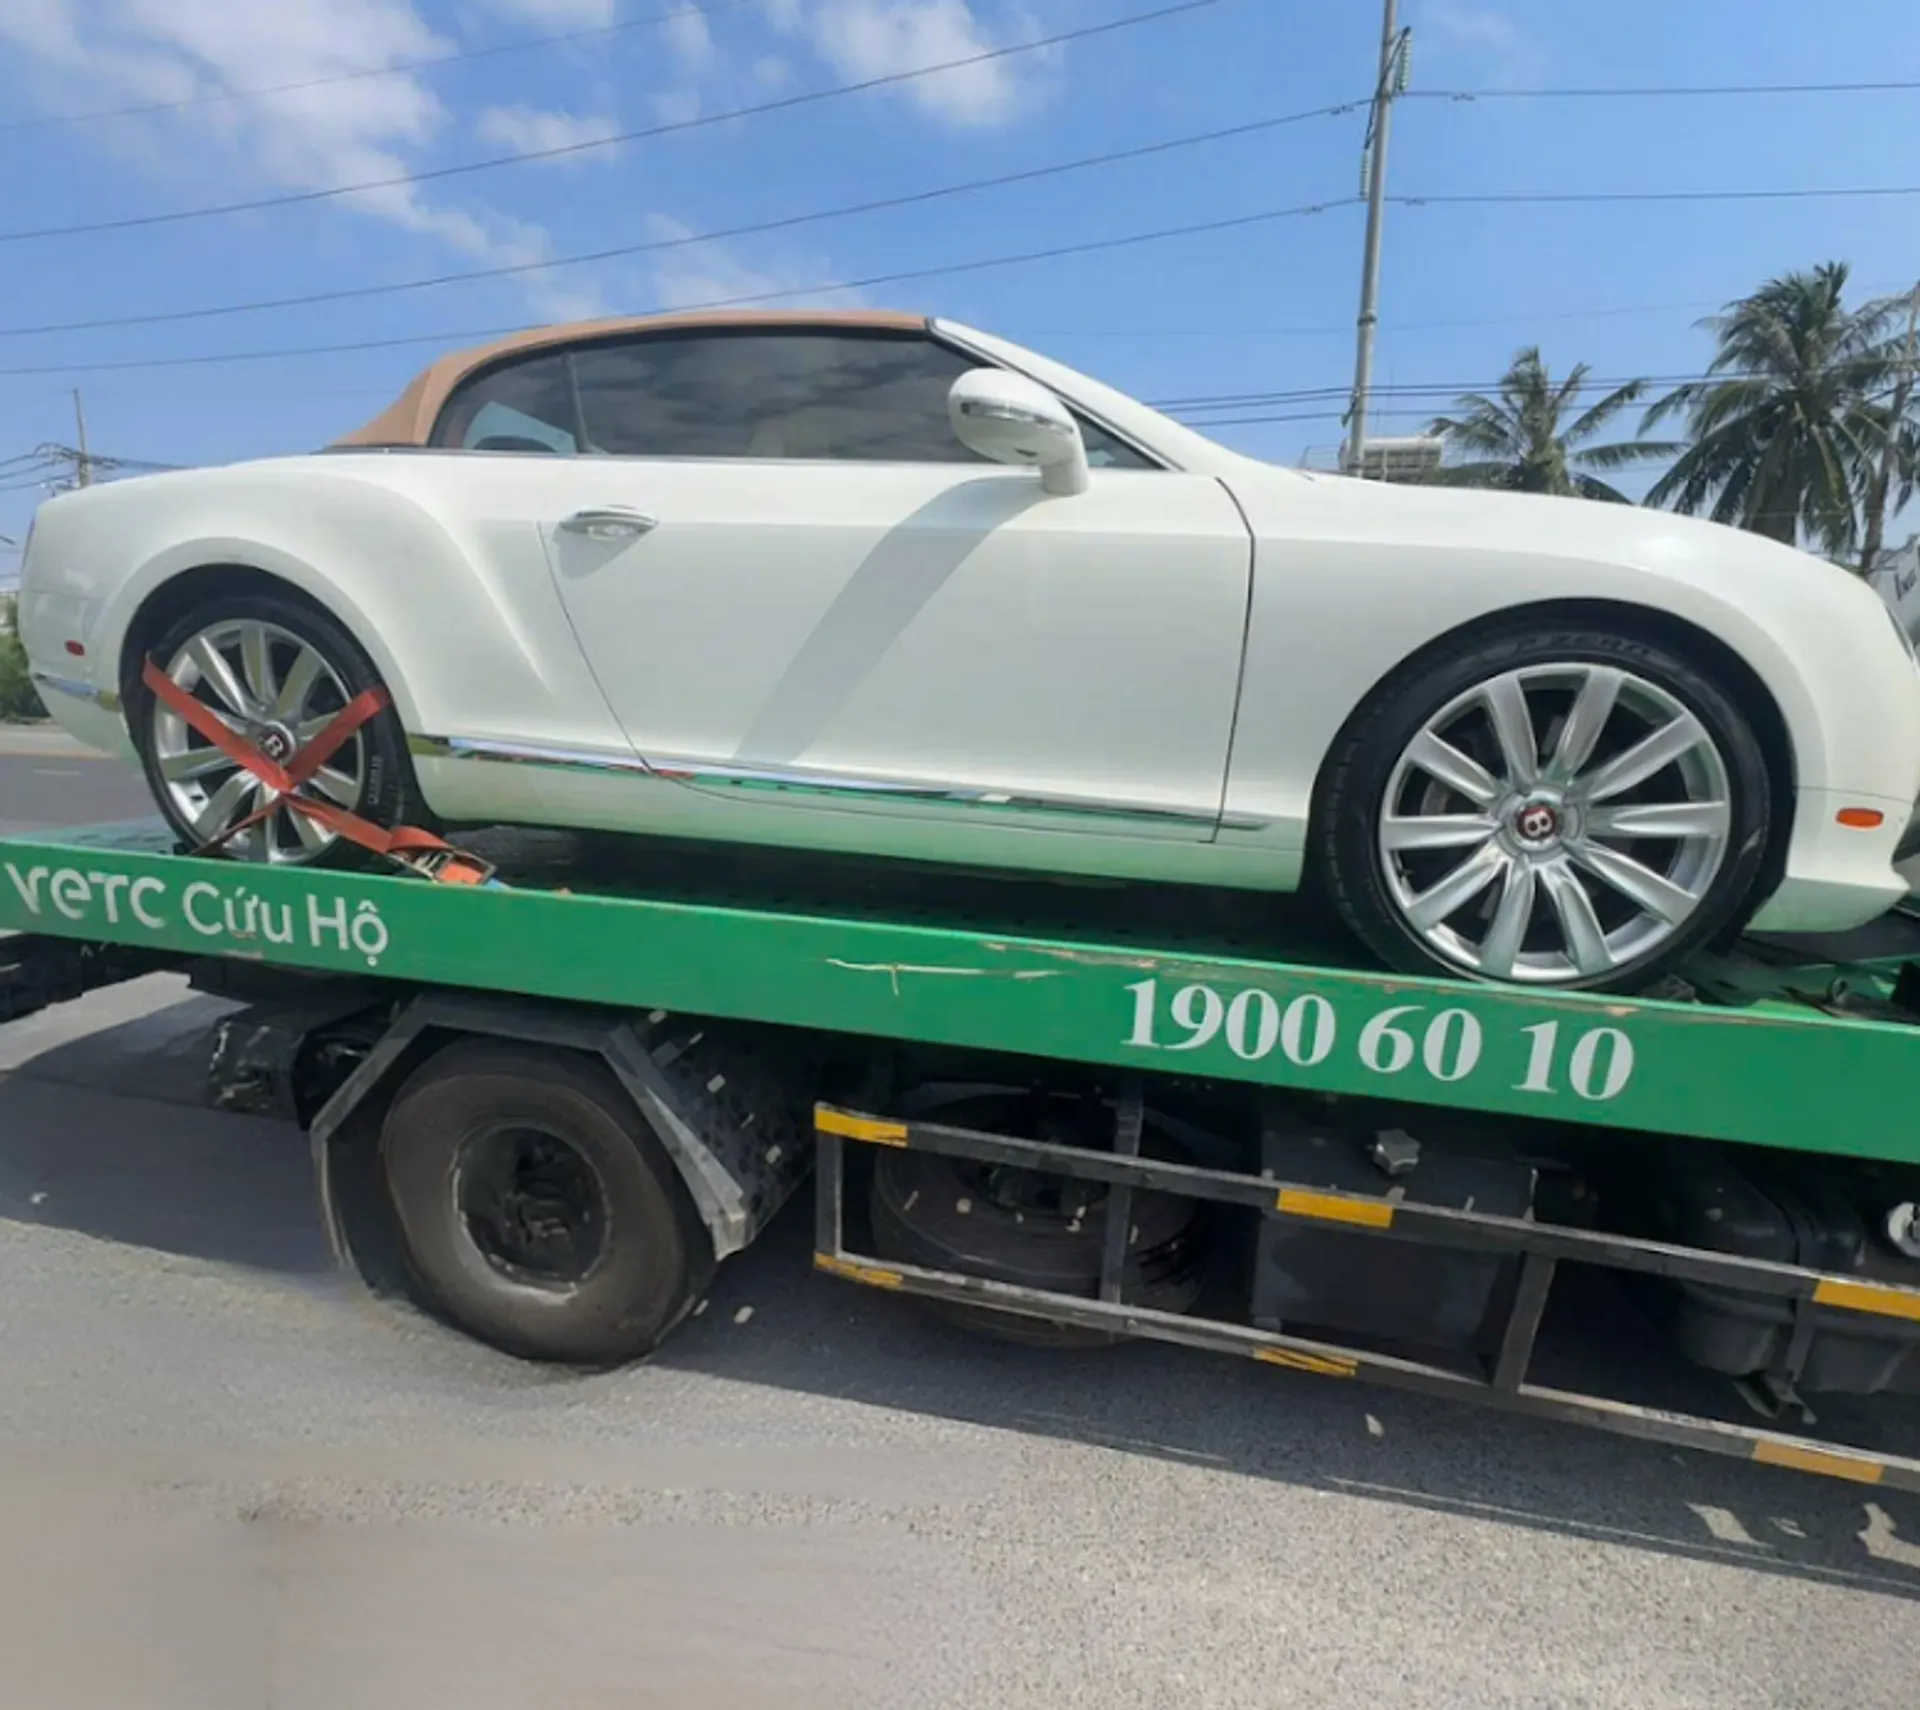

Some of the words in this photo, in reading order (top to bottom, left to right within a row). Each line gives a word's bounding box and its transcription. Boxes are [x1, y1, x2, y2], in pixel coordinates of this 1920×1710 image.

[182, 882, 294, 944] Cứu
[306, 894, 389, 967] Hộ
[1121, 978, 1336, 1066] 1900
[1357, 1005, 1483, 1082] 60
[1511, 1019, 1635, 1101] 10
